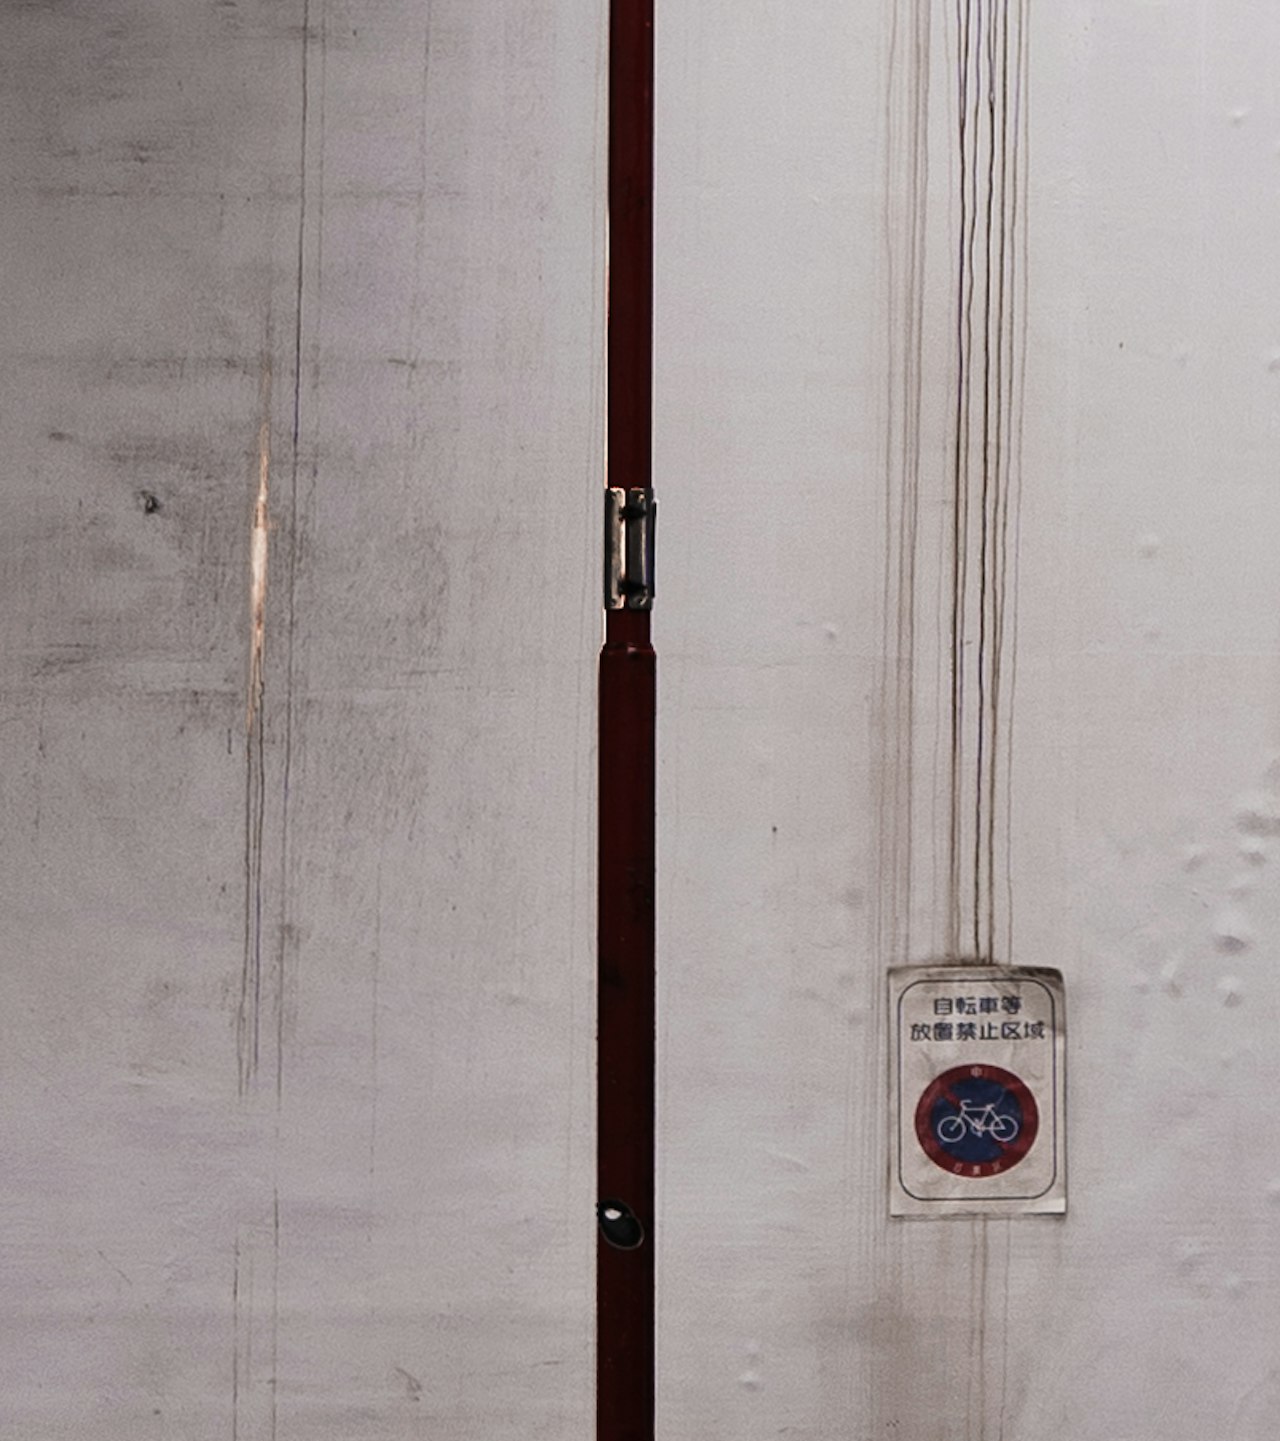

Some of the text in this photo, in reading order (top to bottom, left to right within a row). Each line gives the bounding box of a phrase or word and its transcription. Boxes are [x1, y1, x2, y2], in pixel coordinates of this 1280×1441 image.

[934, 995, 1022, 1015] 自転車等
[910, 1020, 1045, 1041] 放置禁止区域
